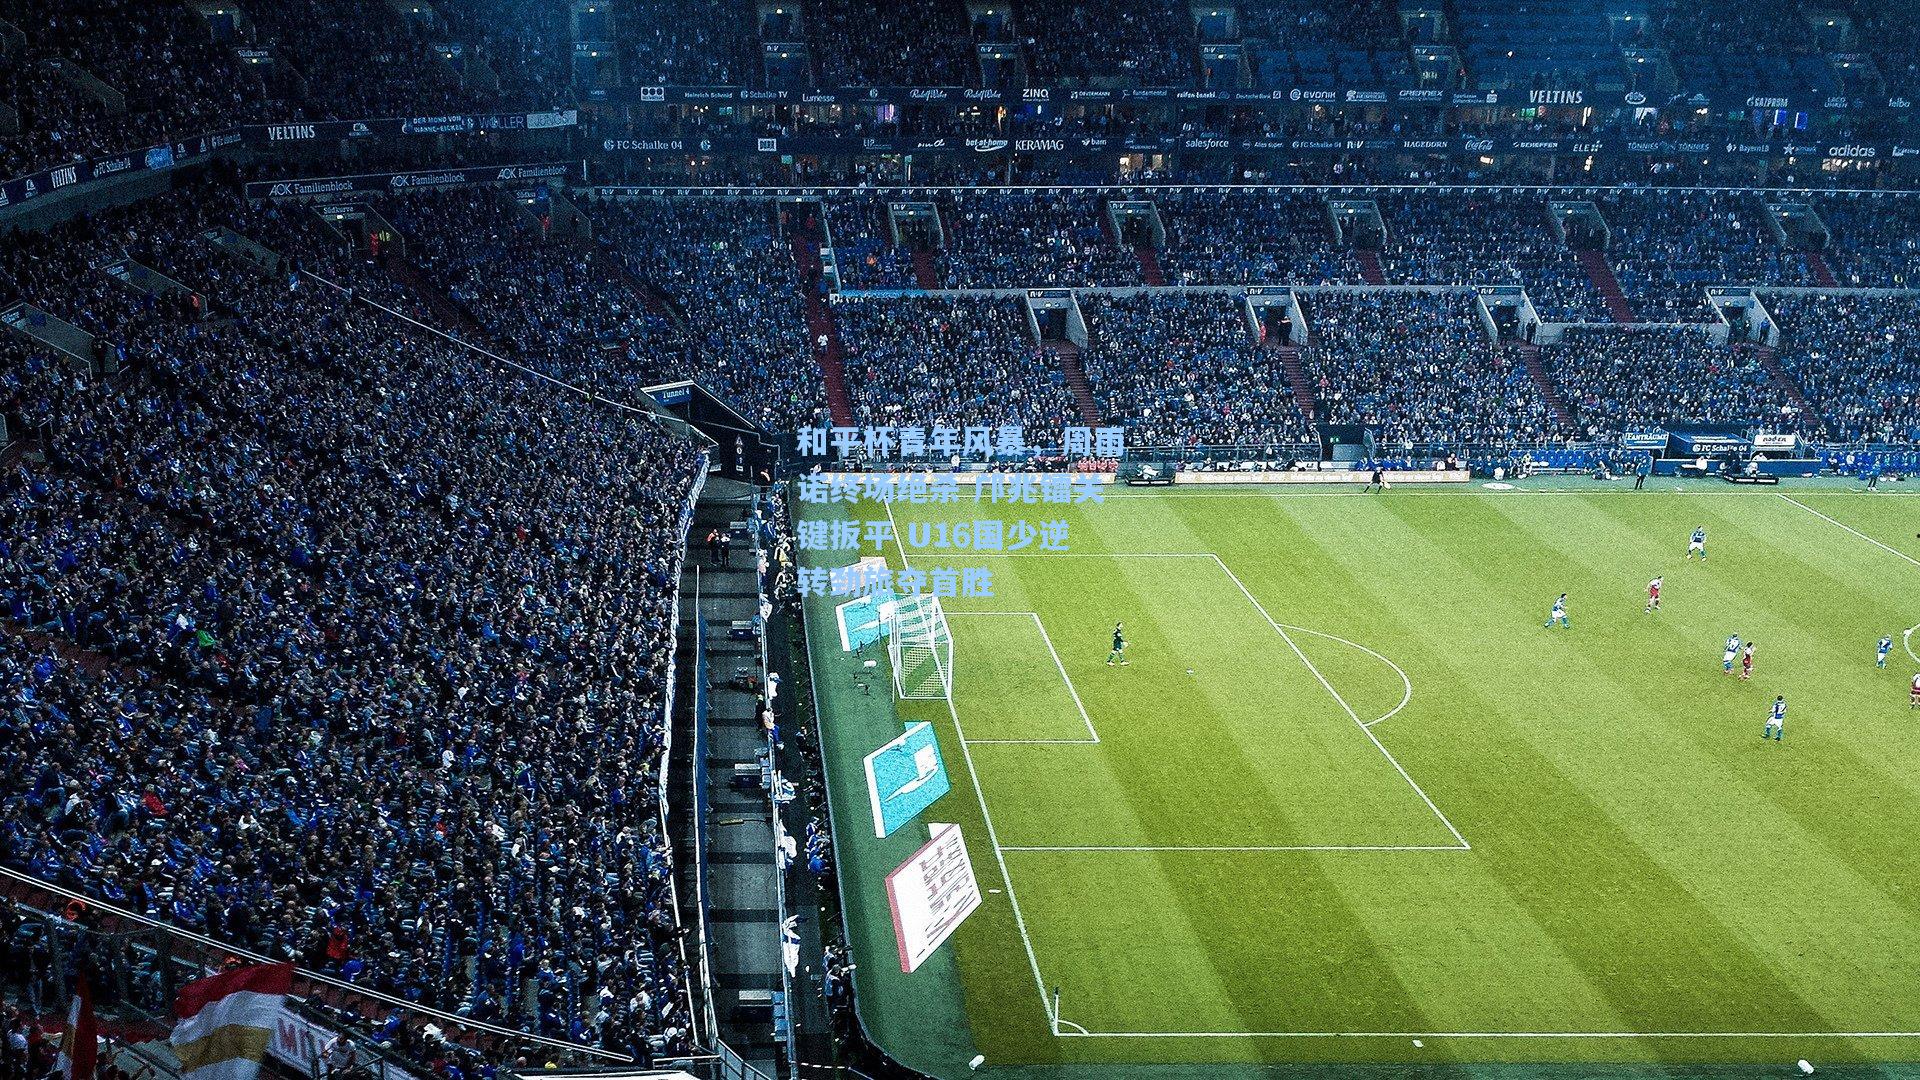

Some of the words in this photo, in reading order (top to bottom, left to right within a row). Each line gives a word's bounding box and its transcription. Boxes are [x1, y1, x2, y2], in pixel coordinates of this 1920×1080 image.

[1022, 88, 1049, 98] ZINQ
[1530, 90, 1583, 104] VELTINS
[268, 125, 315, 140] VELTINS
[617, 140, 630, 150] FC
[632, 140, 669, 150] Schalke
[671, 140, 682, 150] 04
[1015, 140, 1064, 150] KERAMAG
[1186, 138, 1229, 150] salesforce
[1828, 145, 1876, 157] adidas
[518, 166, 568, 178] Familienblock
[411, 172, 466, 186] Familienblock
[294, 180, 353, 194] Familienblock
[662, 389, 685, 399] Tunnel
